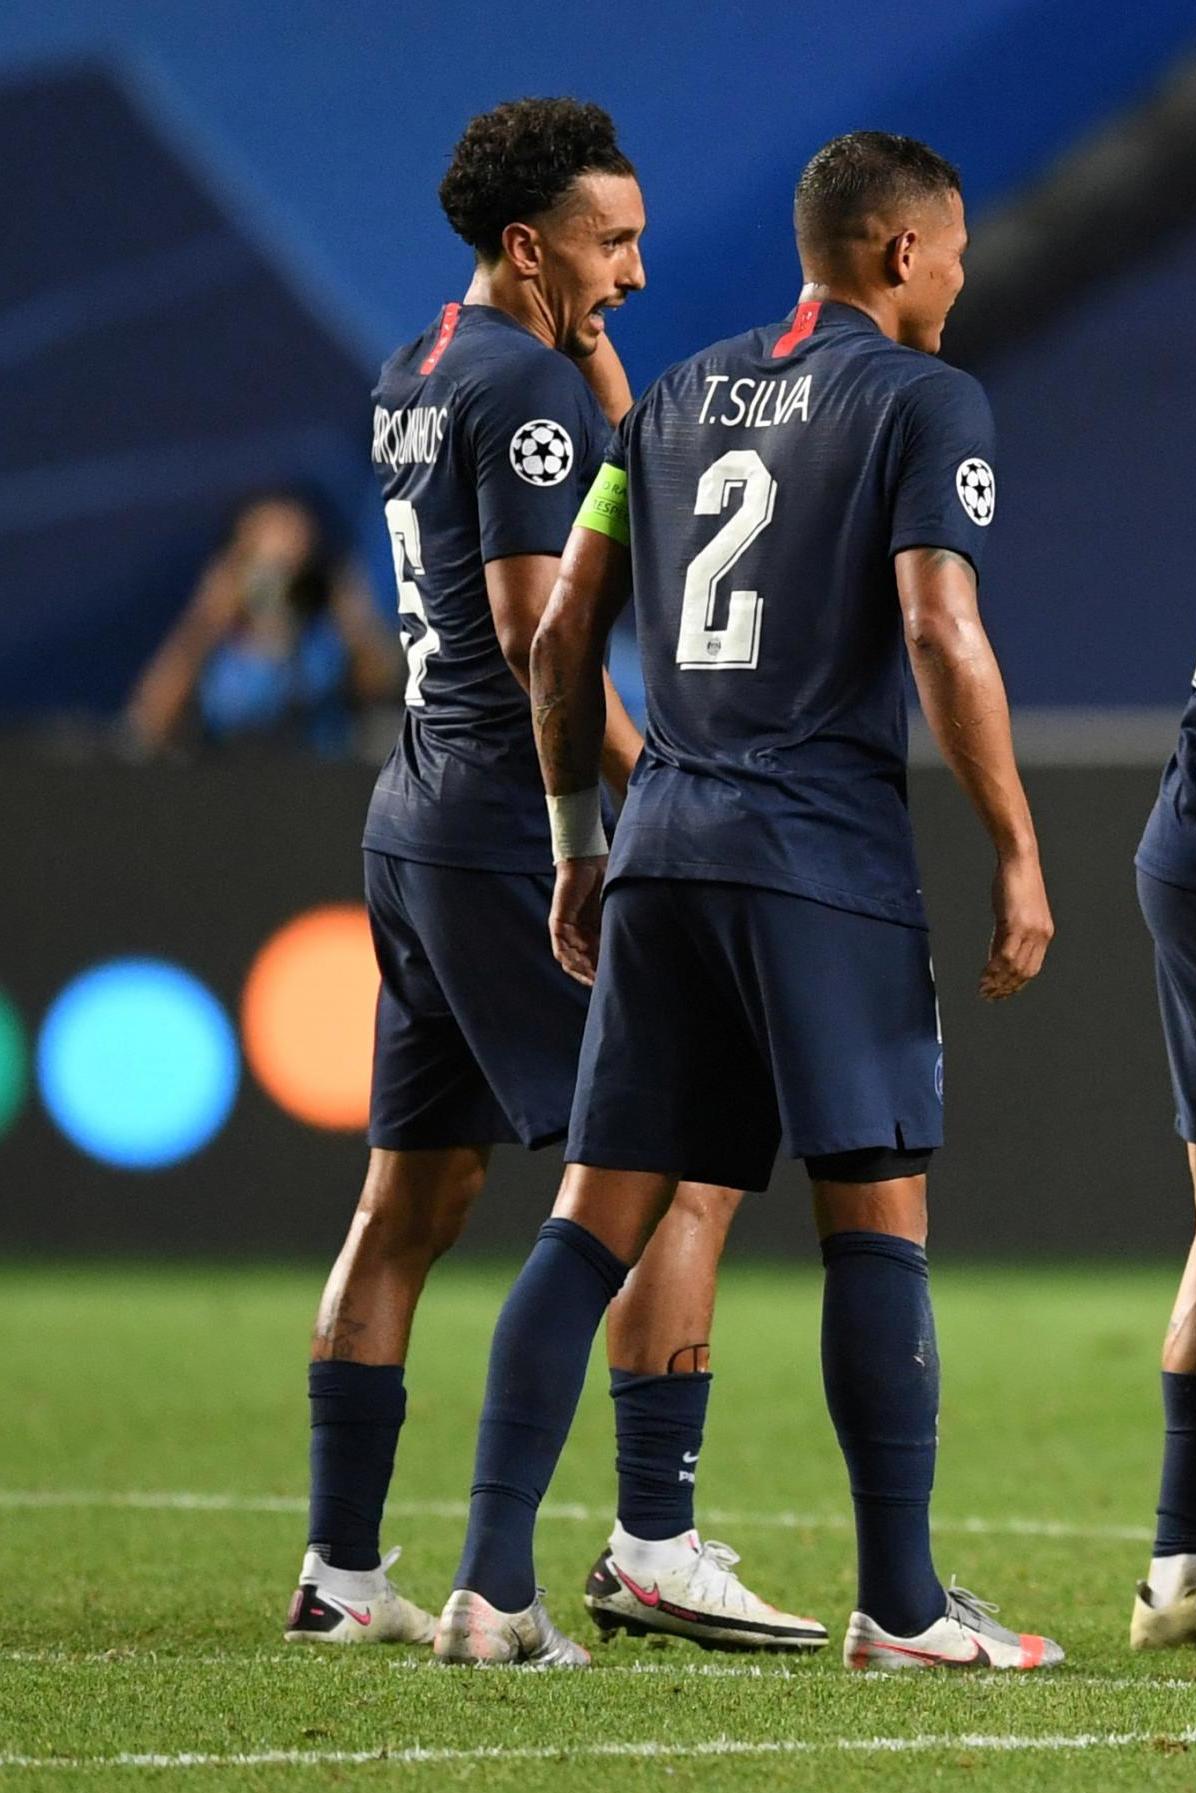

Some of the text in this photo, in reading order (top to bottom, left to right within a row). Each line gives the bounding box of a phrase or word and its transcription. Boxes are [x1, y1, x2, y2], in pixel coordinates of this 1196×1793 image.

[698, 374, 812, 428] T.SILVA
[372, 404, 447, 473] ARQUINHOS
[676, 449, 778, 670] 2
